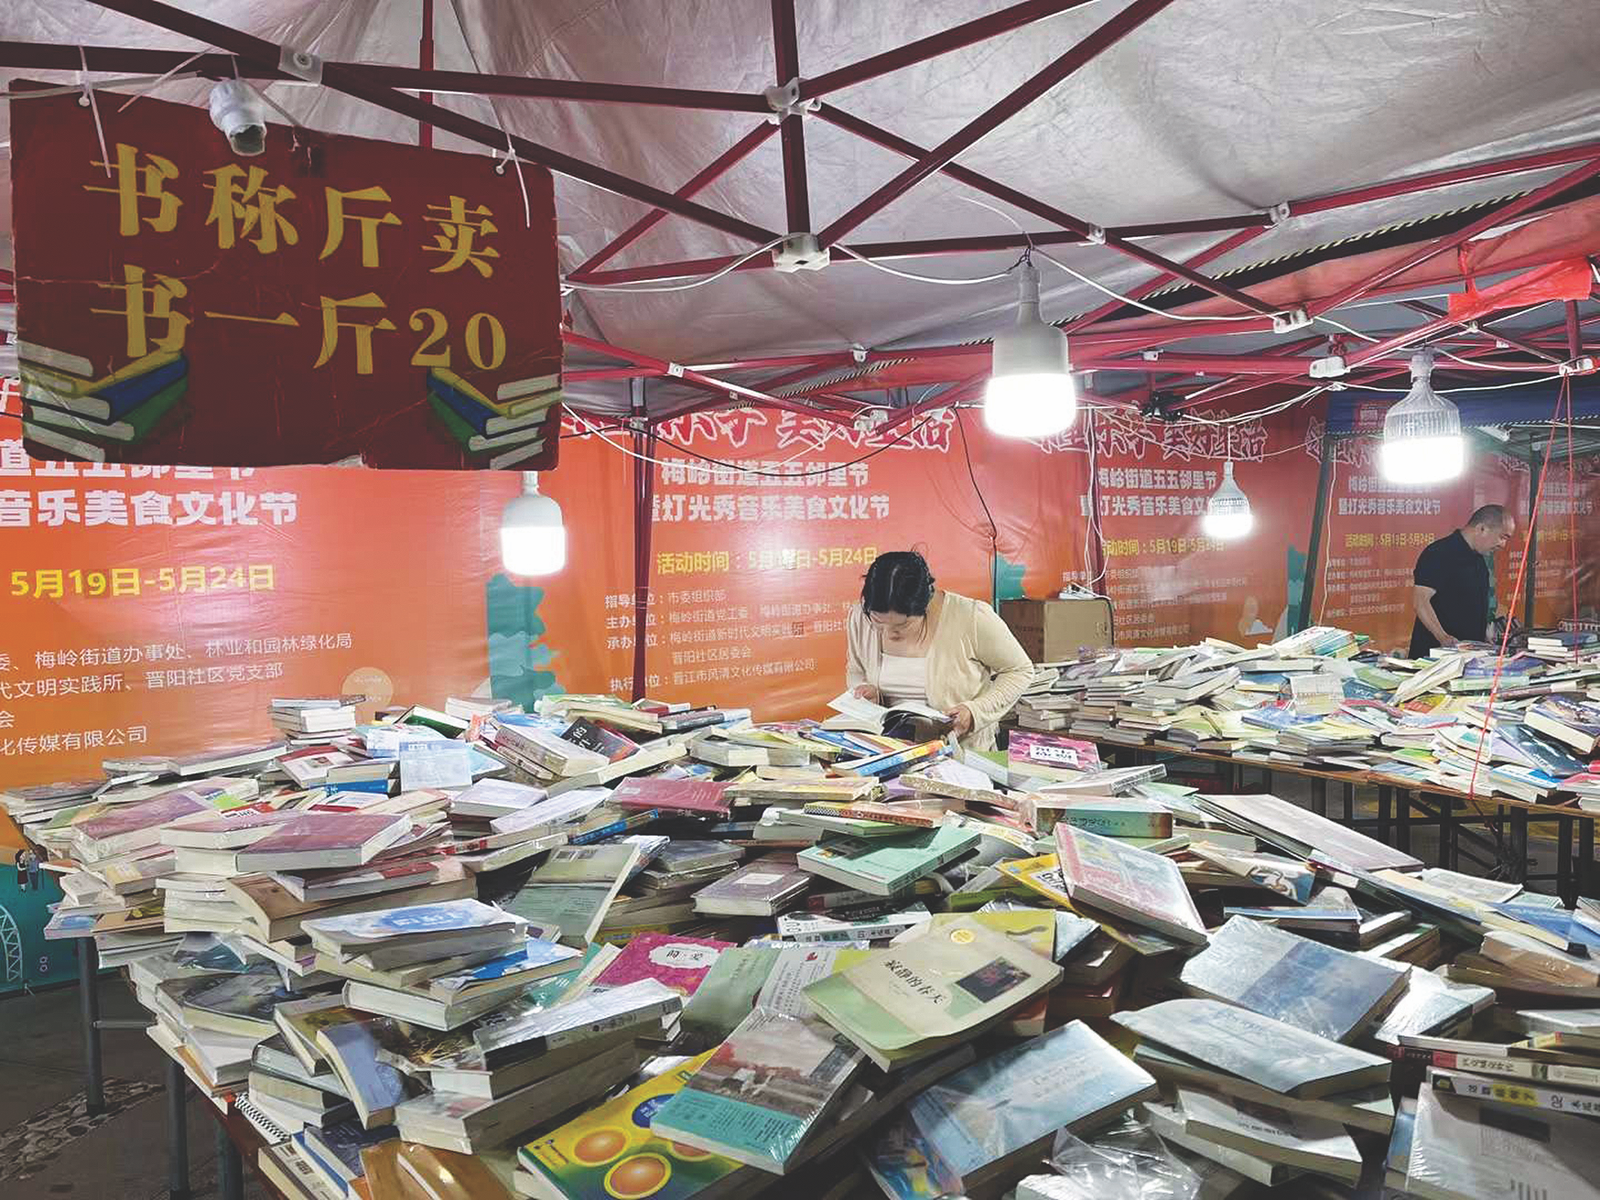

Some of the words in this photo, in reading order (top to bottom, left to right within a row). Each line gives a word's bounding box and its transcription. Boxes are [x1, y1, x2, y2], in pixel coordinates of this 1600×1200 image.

[83, 142, 500, 278] 书称斤卖
[90, 264, 508, 375] 书一斤20
[0, 490, 298, 527] 音乐美食文化节
[10, 564, 276, 599] 5月19日-5月24日
